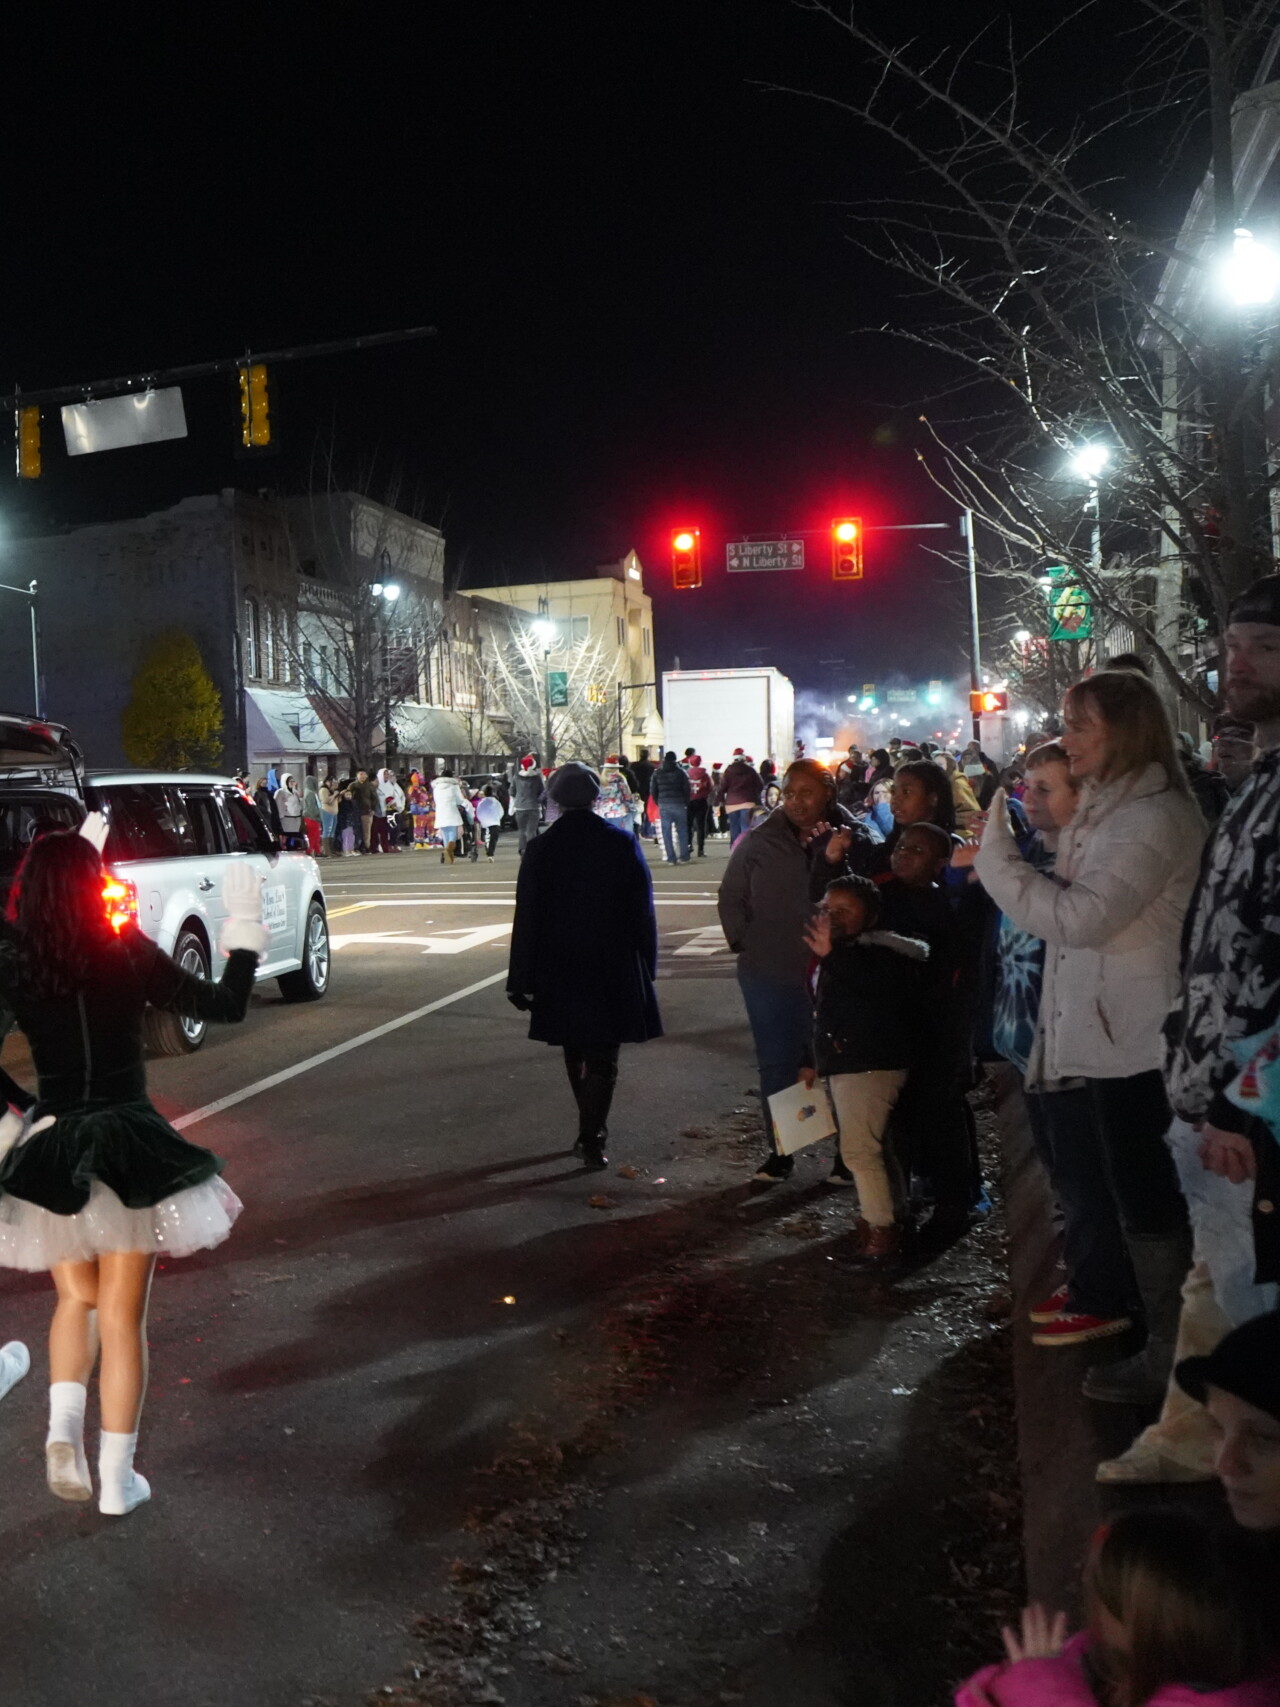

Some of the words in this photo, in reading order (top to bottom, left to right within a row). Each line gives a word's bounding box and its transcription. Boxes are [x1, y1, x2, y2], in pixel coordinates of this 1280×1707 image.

[729, 545, 735, 555] S
[739, 544, 773, 556] Liberty
[777, 543, 787, 553] St
[742, 557, 750, 567] N
[753, 556, 788, 567] Liberty
[792, 555, 801, 565] St
